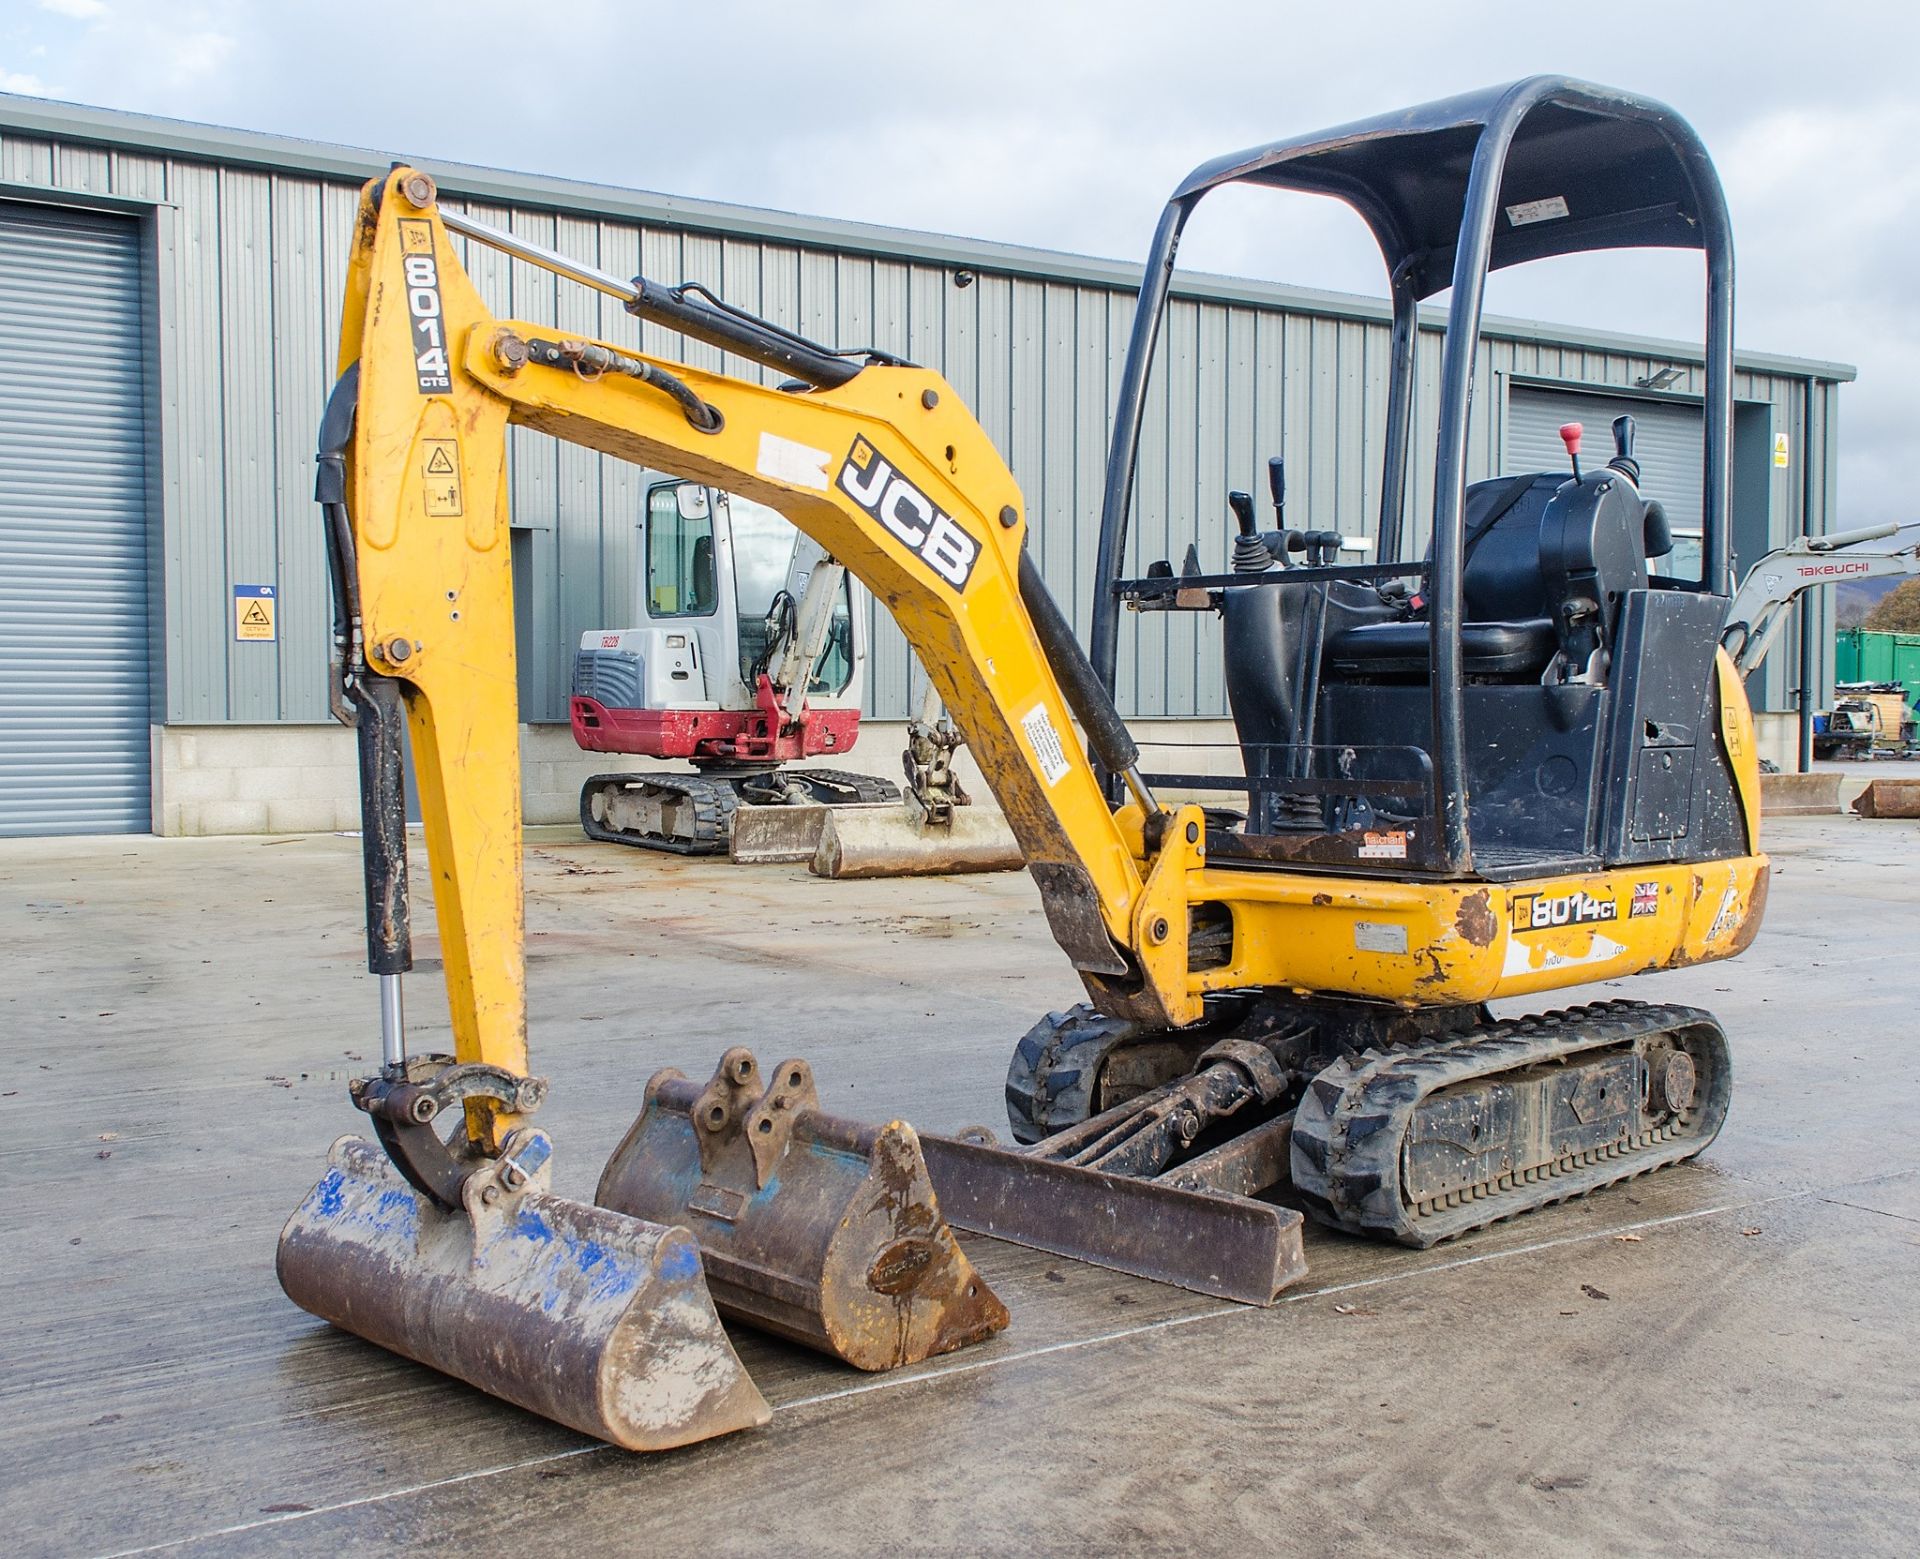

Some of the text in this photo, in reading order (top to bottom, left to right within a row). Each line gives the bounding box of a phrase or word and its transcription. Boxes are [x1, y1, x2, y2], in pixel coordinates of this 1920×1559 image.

[404, 257, 449, 377] 8014
[419, 376, 450, 388] CTS
[842, 460, 975, 585] JCB
